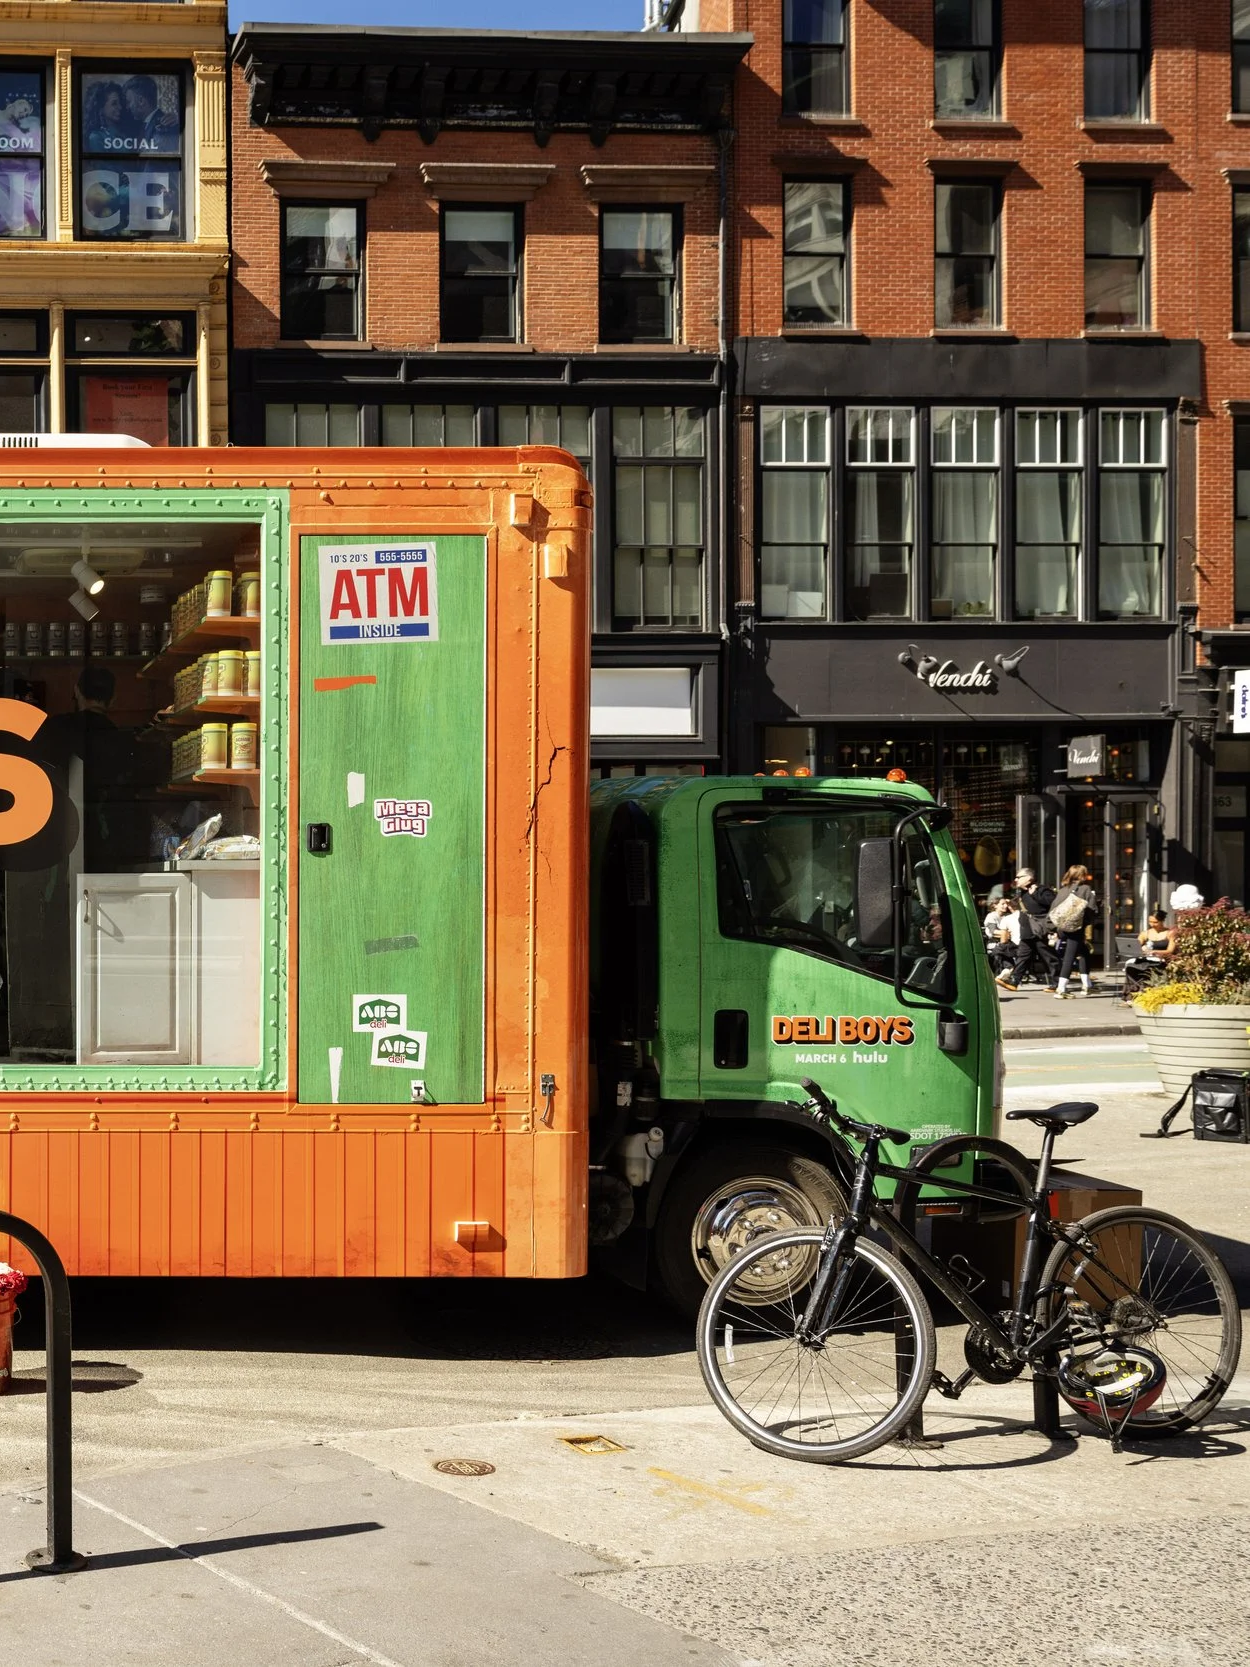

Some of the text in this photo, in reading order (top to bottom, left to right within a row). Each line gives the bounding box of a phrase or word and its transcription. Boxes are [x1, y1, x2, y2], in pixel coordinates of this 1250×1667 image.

[103, 137, 159, 150] SOCIAL
[330, 554, 368, 563] 10'S 20'S
[379, 551, 423, 562] 555-5555
[329, 566, 429, 620] ATM
[359, 624, 401, 638] INSIDE
[917, 660, 992, 687] Venchi
[376, 801, 430, 818] Mega
[383, 817, 424, 835] Glug
[361, 1005, 398, 1018] ABC
[370, 1018, 388, 1029] deli
[772, 1016, 914, 1044] DELI BOYS
[380, 1039, 418, 1054] ABC
[388, 1053, 406, 1063] deli
[795, 1051, 888, 1063] MARCH 6 hulu
